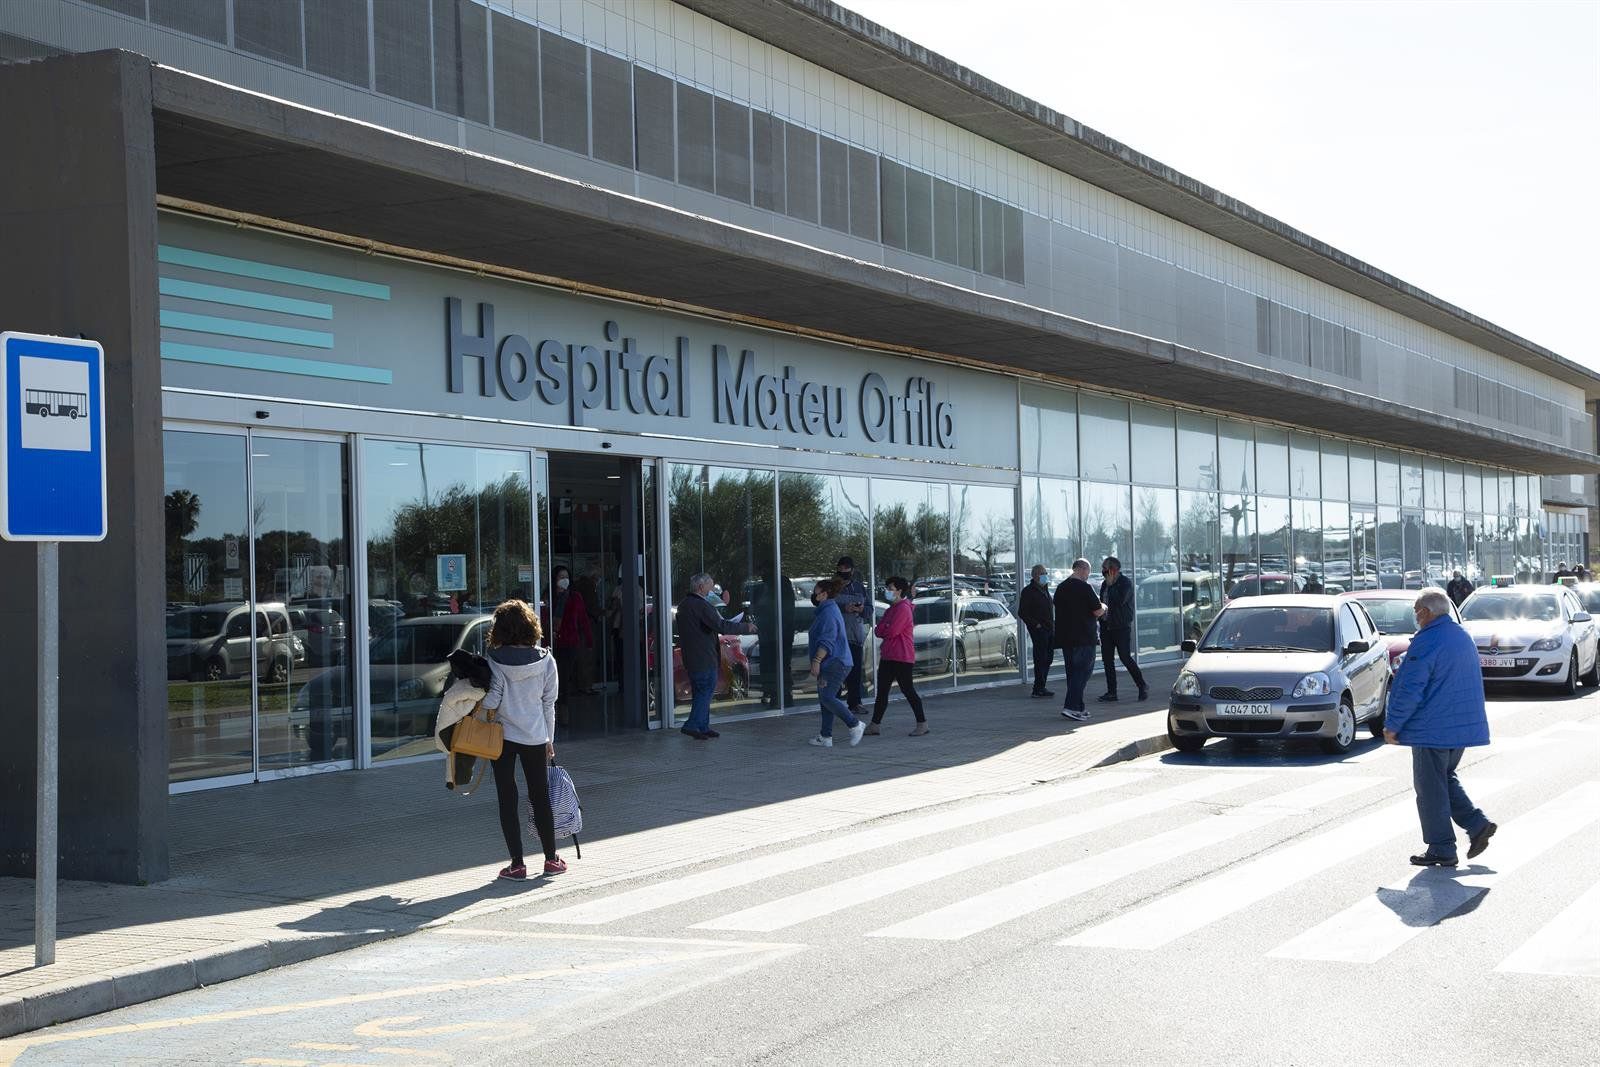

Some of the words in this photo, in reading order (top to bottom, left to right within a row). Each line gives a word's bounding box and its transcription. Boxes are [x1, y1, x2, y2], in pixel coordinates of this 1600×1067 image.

[444, 297, 690, 426] Hospital
[712, 344, 847, 438] Mateu
[859, 372, 956, 449] Orfila
[1224, 704, 1249, 714] 4047
[1251, 704, 1269, 714] DCX
